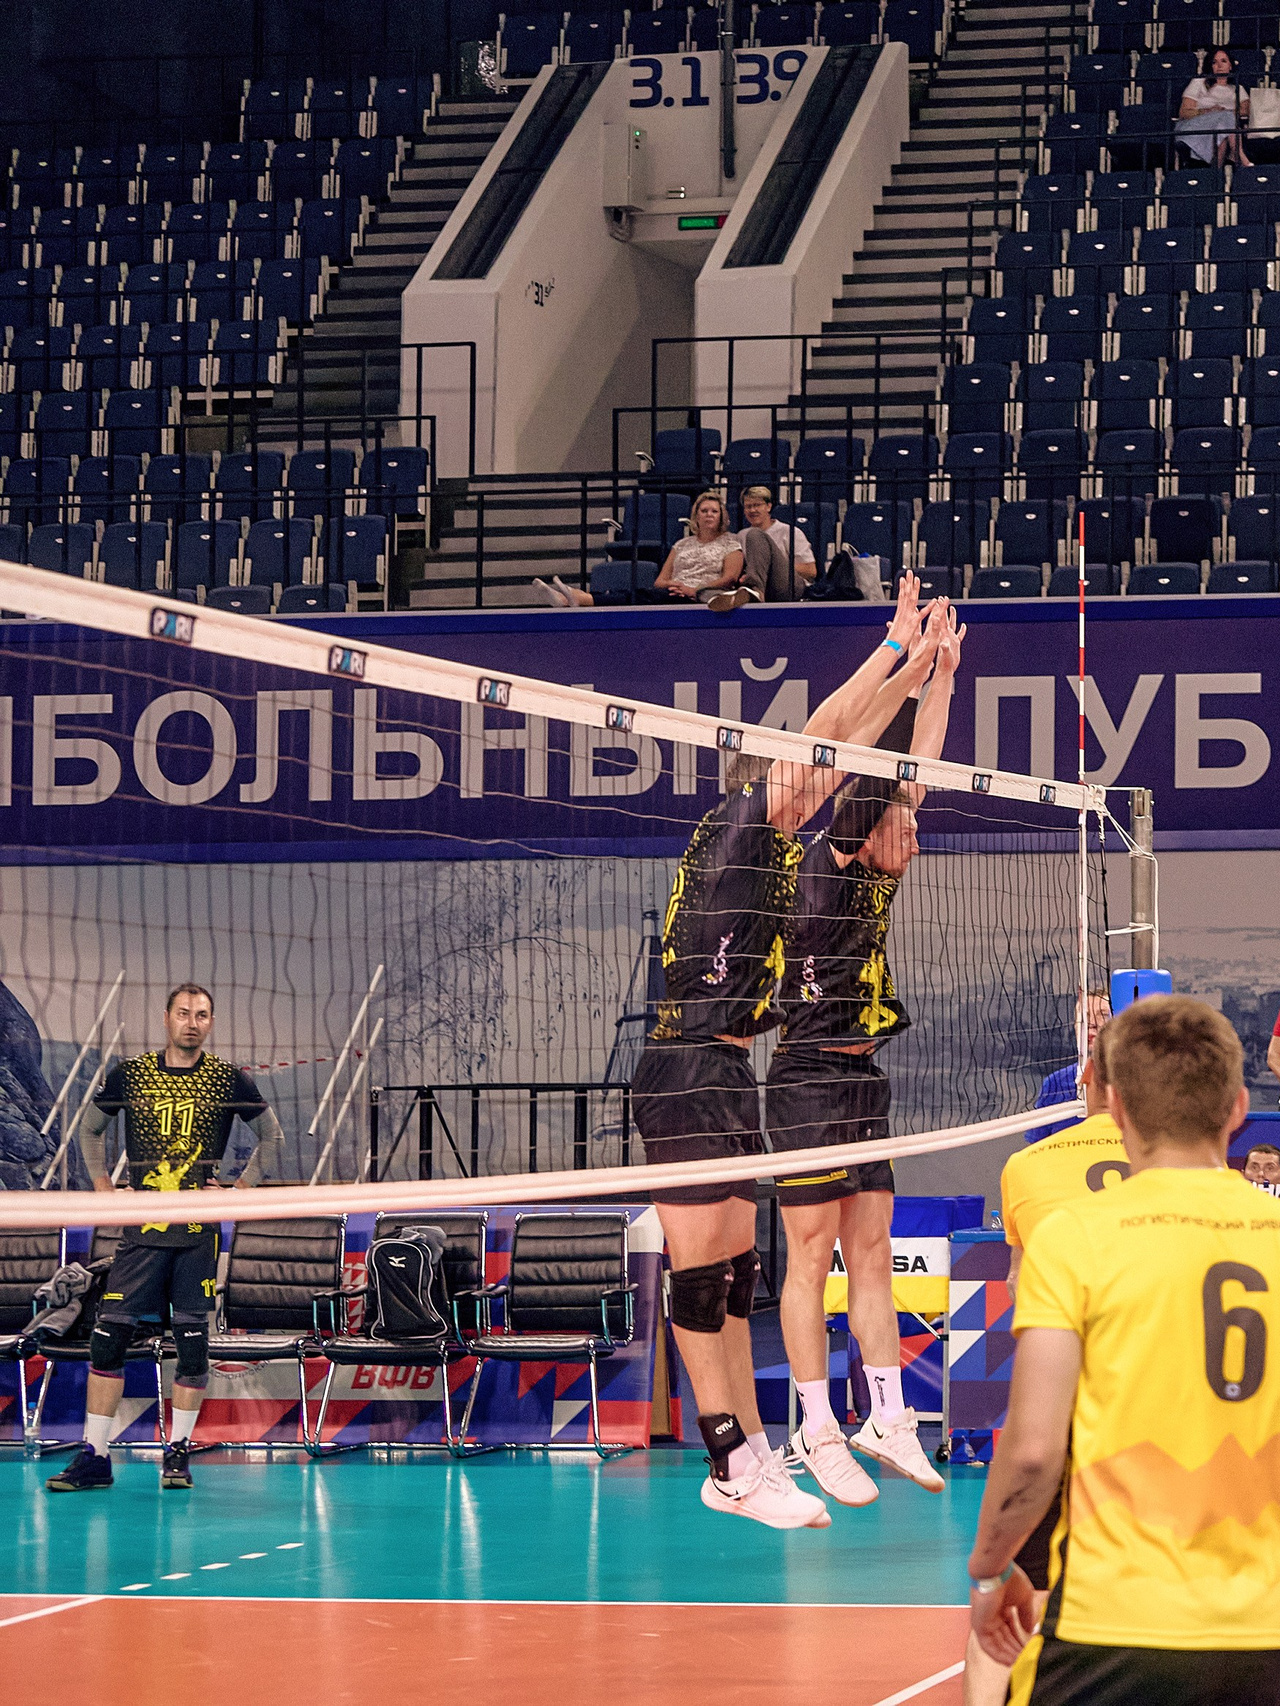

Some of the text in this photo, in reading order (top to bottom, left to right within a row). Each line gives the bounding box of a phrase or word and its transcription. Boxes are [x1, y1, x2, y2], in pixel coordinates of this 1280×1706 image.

[629, 57, 709, 108] 3.1
[0, 657, 808, 806] БОЛЬНЫЙ
[154, 1098, 195, 1136] 11
[1027, 1138, 1124, 1157] ЛОГИСТИЧЕСКИ
[1202, 1261, 1270, 1402] 6
